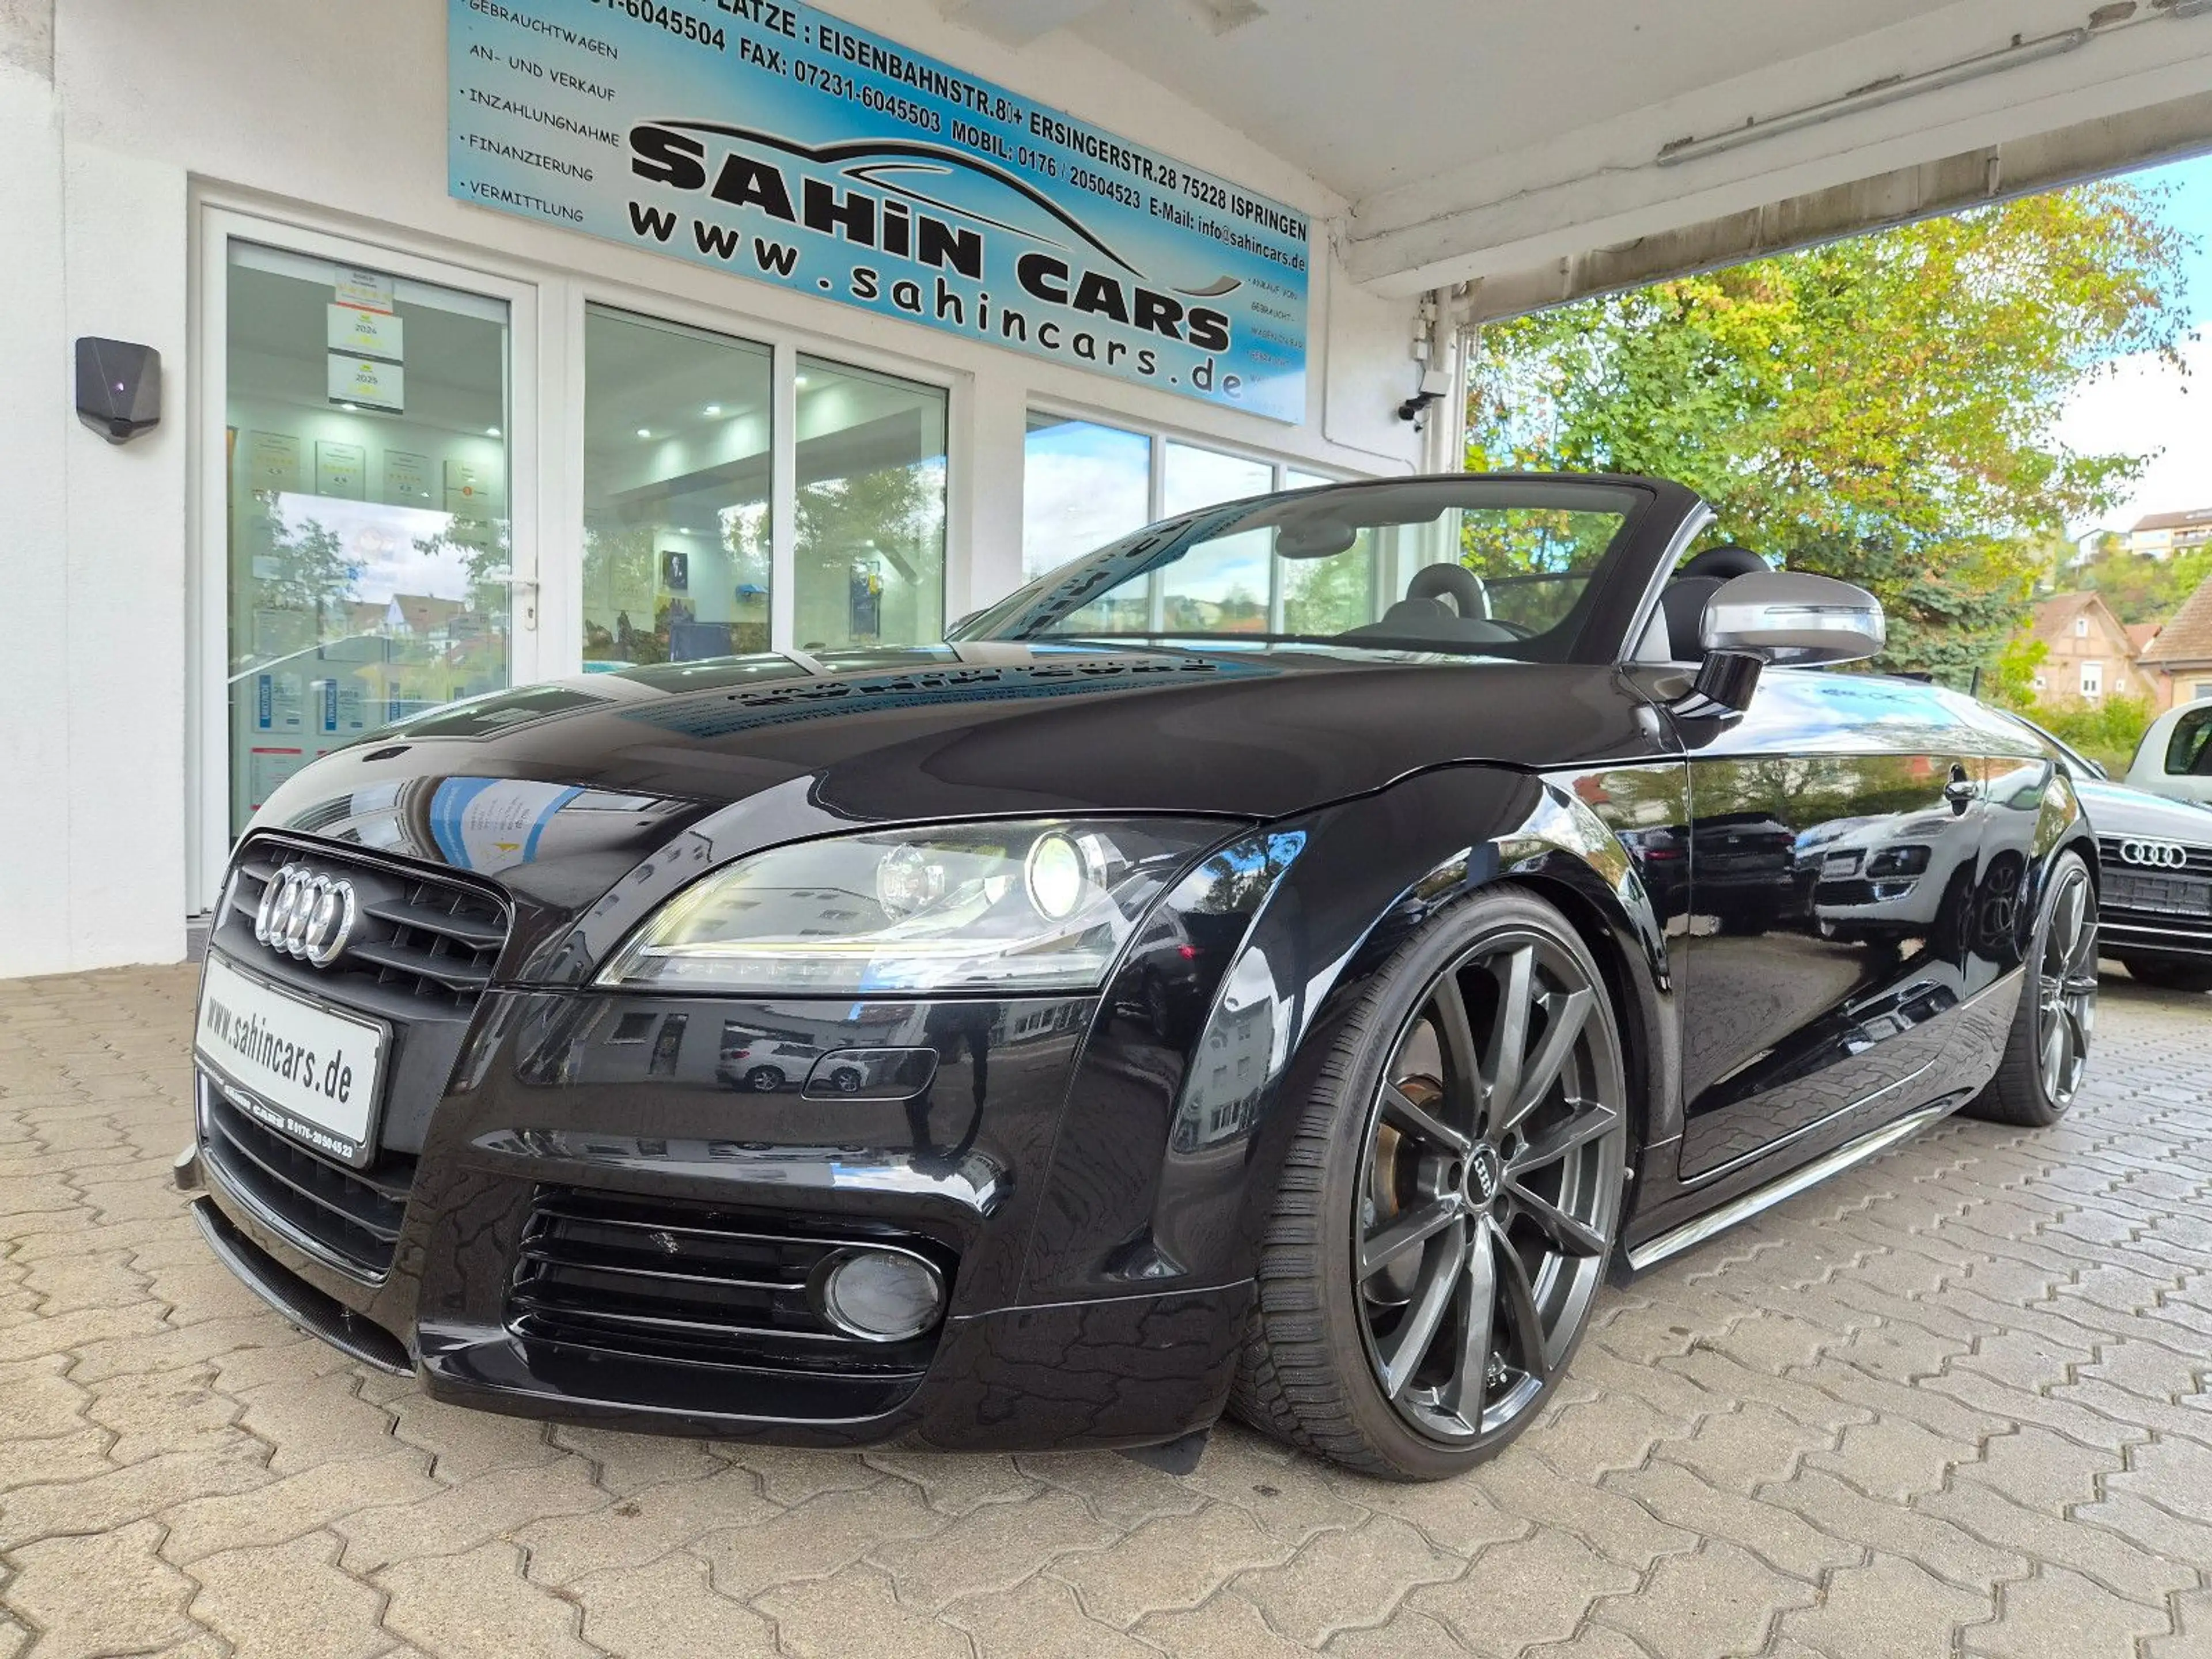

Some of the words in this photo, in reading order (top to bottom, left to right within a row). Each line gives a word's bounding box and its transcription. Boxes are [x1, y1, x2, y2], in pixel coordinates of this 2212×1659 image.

[469, 0, 618, 59] GEBRAUCHTWAGEN
[469, 45, 501, 61] AN-
[509, 56, 543, 77] UND
[550, 69, 616, 101] VERKAUF
[469, 88, 620, 147] INZAHLUNGNAHME
[741, 37, 786, 75] FAX:
[795, 59, 940, 132] 07231-6045503
[952, 120, 1012, 161] MOBIL:
[1018, 147, 1055, 176] 0176
[1070, 166, 1140, 209] 20504523
[1150, 196, 1194, 229] E-Mail:
[469, 134, 593, 181] FINANZIERUNG
[1031, 112, 1176, 190] ERSINGERSTR.28
[1182, 175, 1226, 209] 75228
[1232, 195, 1306, 242] ISPRINGEN
[470, 180, 584, 222] VERMITTLUNG
[1017, 253, 1229, 352] CARS
[207, 997, 352, 1103] www.sahincars.de
